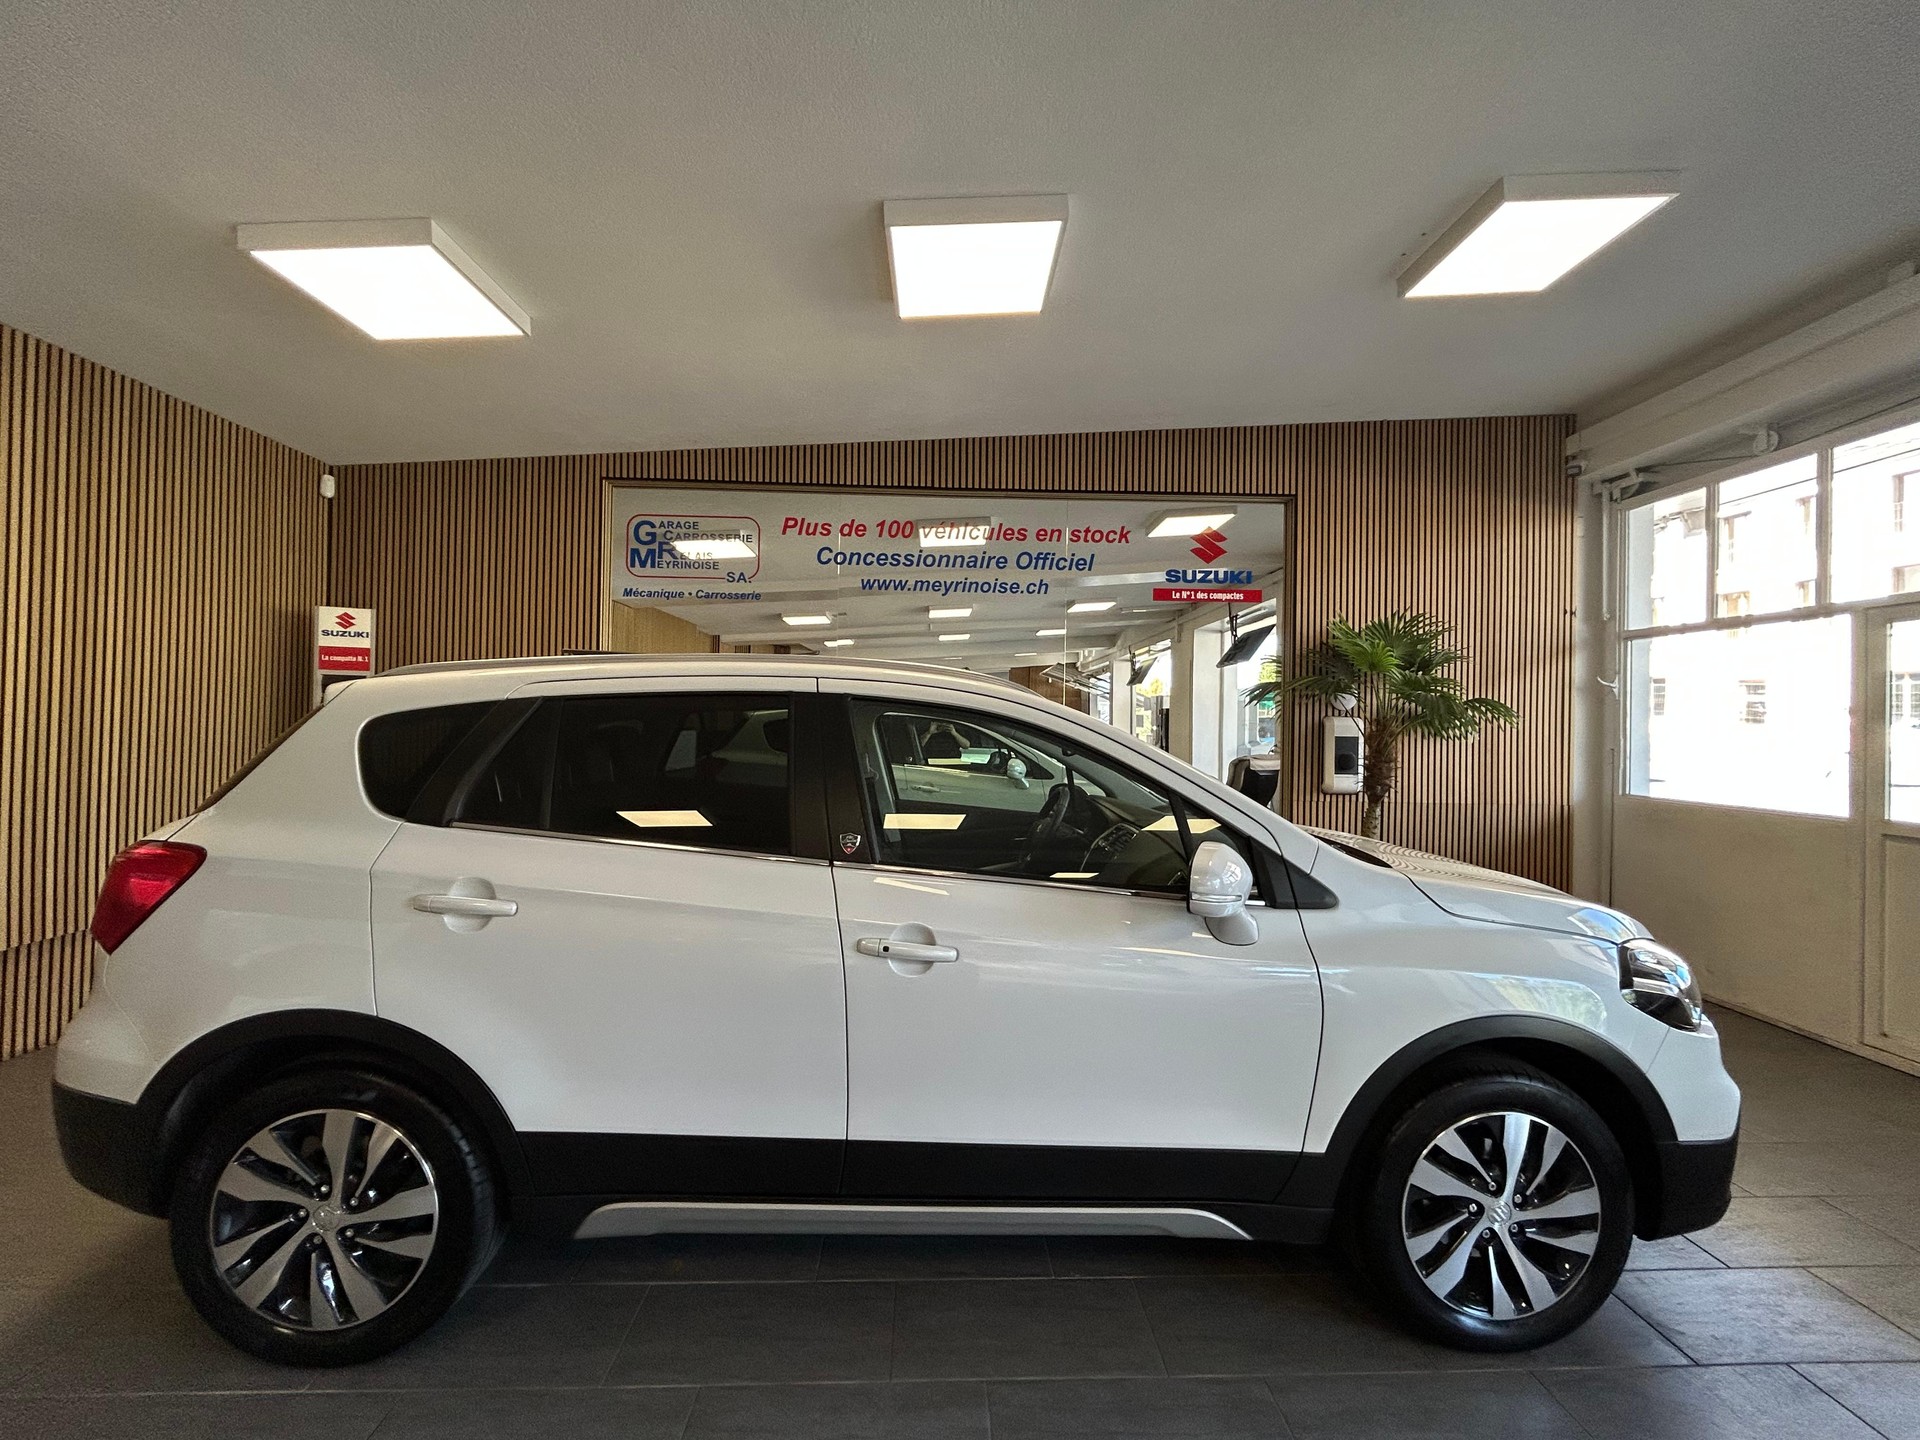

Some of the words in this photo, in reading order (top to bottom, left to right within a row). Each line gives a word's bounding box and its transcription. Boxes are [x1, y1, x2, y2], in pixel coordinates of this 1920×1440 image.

[663, 530, 753, 543] CARROSSERIE
[781, 517, 831, 537] Plus
[839, 518, 867, 537] de
[876, 520, 914, 538] 100
[920, 523, 1027, 543] véhicules
[1036, 529, 1062, 542] en
[1070, 525, 1131, 544] stock
[817, 546, 1008, 570] Concessionnaire
[1016, 552, 1095, 571] Officiel
[1165, 569, 1252, 584] SUZUKI
[861, 577, 1049, 596] www.meyrinoise.ch
[623, 587, 685, 600] Mécanique
[696, 590, 761, 601] Carrosserie
[1172, 590, 1180, 599] Le
[1197, 591, 1208, 599] des
[1209, 592, 1244, 600] compactes
[321, 630, 369, 638] SUZUKI
